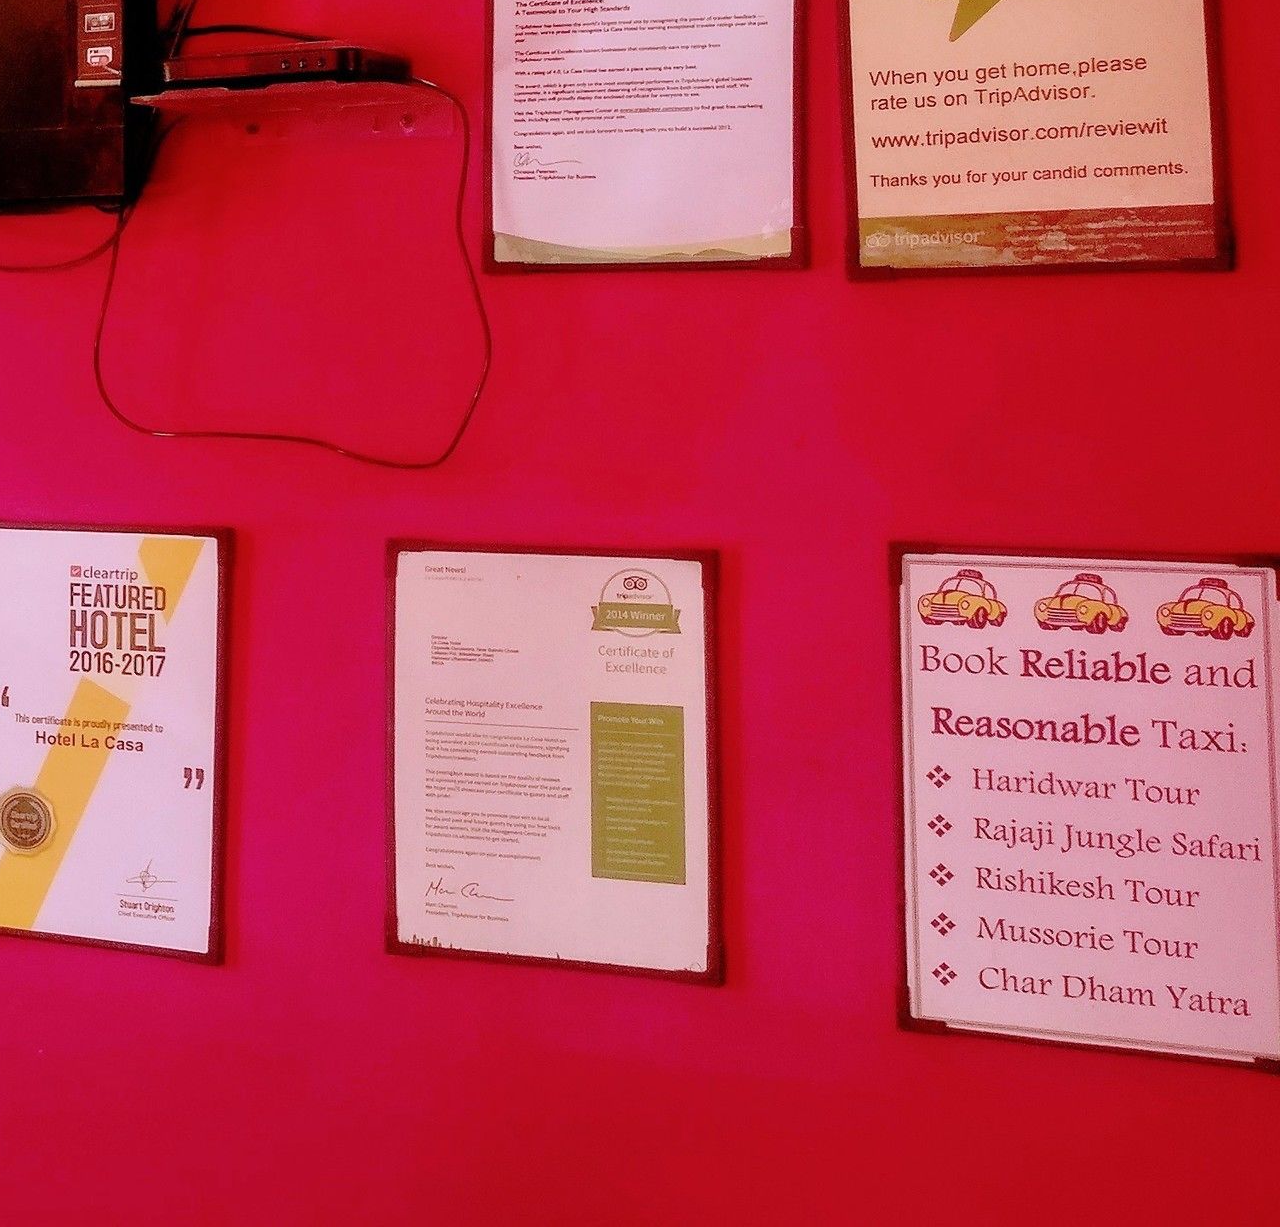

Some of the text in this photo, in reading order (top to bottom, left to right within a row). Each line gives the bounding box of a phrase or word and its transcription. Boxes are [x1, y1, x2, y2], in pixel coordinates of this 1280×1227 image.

[869, 68, 928, 87] When
[934, 67, 969, 86] you
[975, 65, 1007, 81] get
[871, 119, 1168, 149] www.tripadvisor.com/reviewit
[870, 161, 1188, 189] Thanks you for your candid comments.
[83, 566, 138, 582] cleartrip
[69, 584, 166, 612] FEATURED
[69, 609, 166, 653] HOTEL
[69, 651, 166, 677] 2016-2017
[919, 644, 1258, 689] Book Reliable and
[35, 730, 144, 752] Hotel La Casa
[931, 707, 1140, 746] Reasonable
[972, 769, 1200, 806] Haridwar Tour
[973, 817, 1262, 862] Rajaji Jungle Safari
[976, 867, 1200, 908] Rishikesh Tour
[977, 917, 1199, 959] Mussorie Tour
[978, 967, 1251, 1017] Char Dham Yatra
